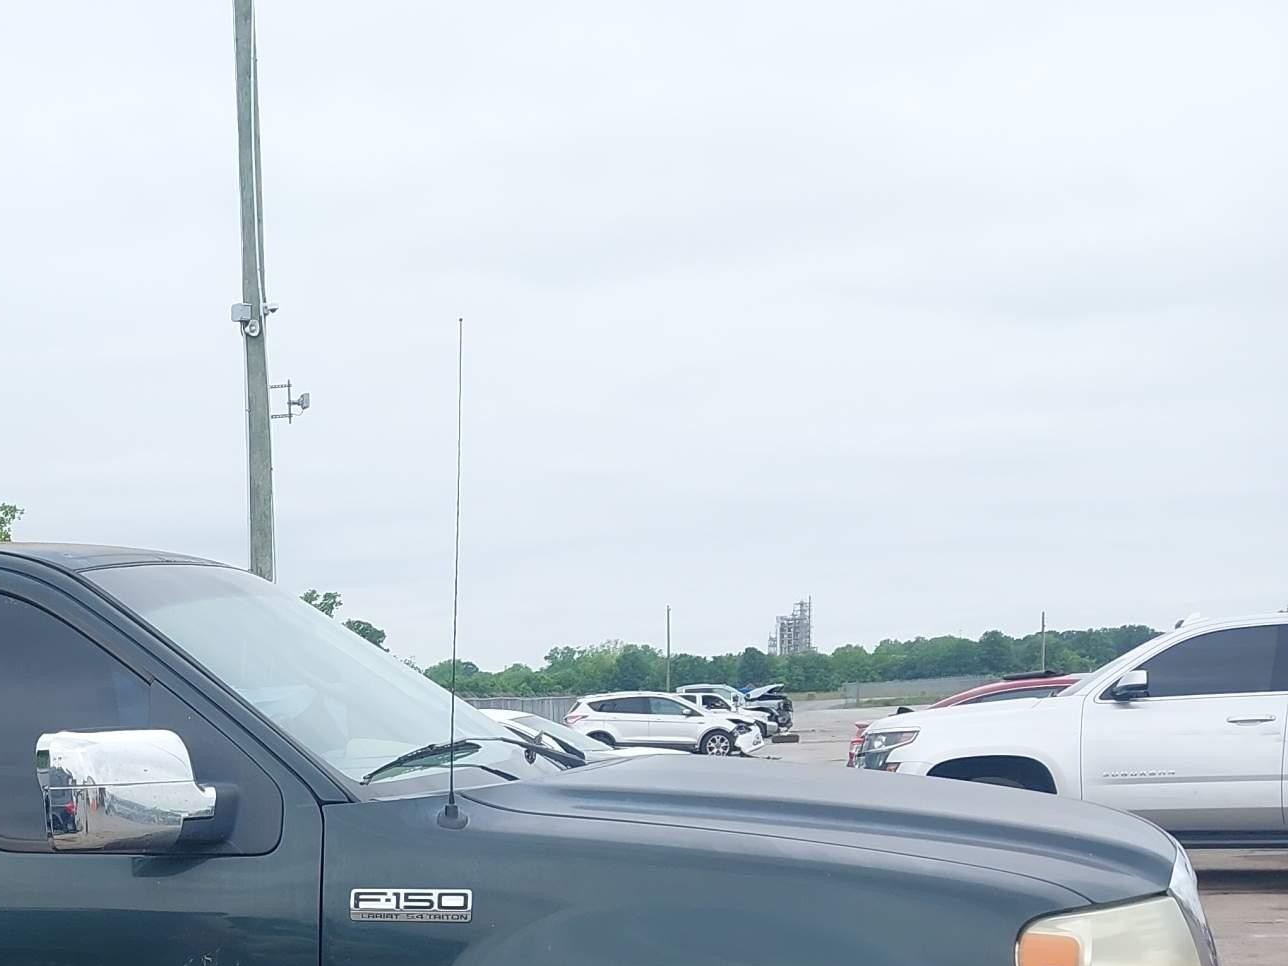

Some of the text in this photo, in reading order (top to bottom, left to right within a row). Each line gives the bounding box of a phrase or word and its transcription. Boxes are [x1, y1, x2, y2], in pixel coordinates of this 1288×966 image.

[353, 891, 469, 911] F-150
[360, 912, 400, 920] LARIAT
[426, 912, 469, 921] TRITON
